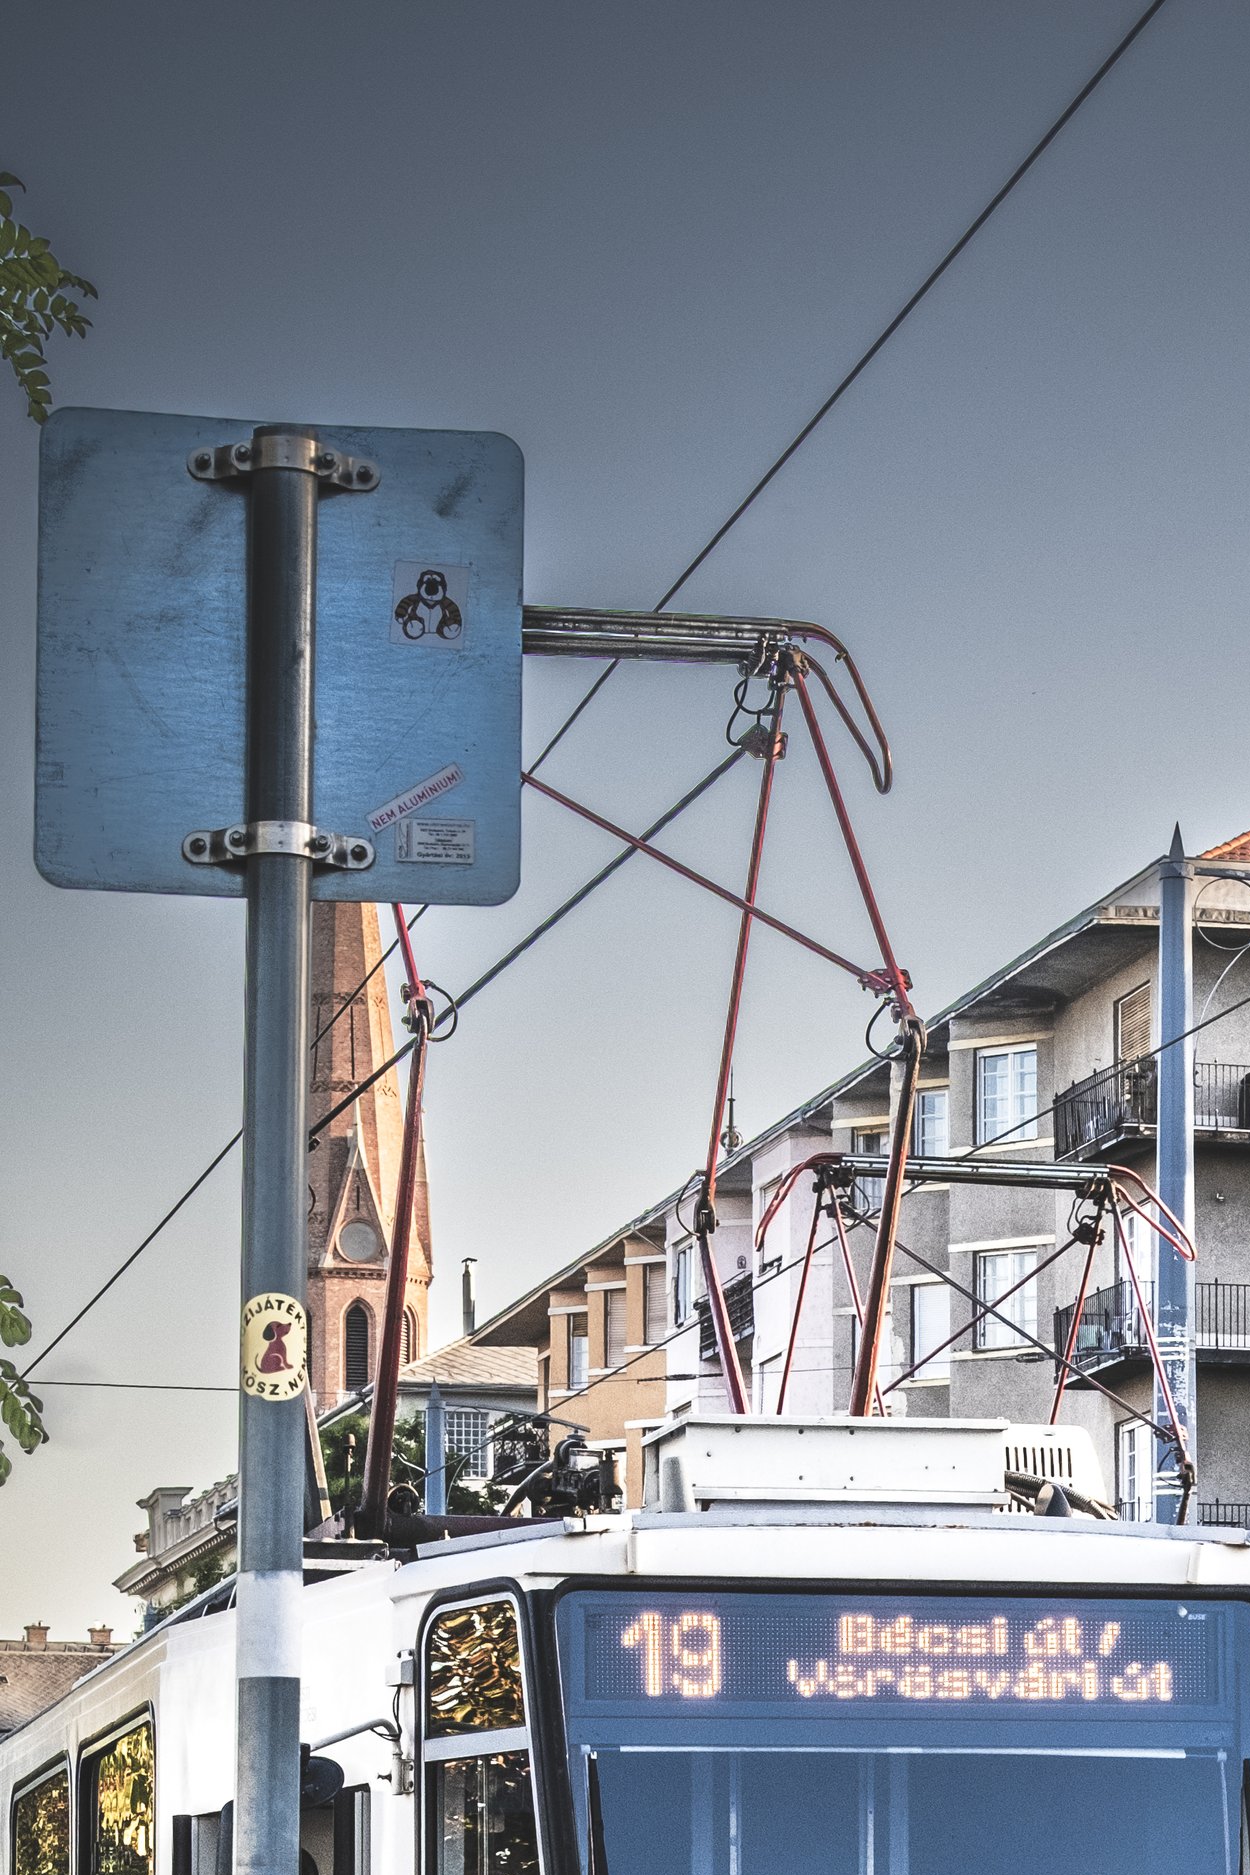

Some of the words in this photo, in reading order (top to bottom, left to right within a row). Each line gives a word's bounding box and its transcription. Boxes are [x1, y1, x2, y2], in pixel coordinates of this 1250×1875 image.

[371, 809, 397, 829] NEM
[398, 770, 460, 815] ALUMÍNIUM!
[242, 1296, 305, 1334] ZIJÁTÉK
[621, 1612, 721, 1697] 19
[838, 1614, 1007, 1656] Bécsi
[1023, 1616, 1083, 1656] út
[786, 1659, 1098, 1700] Vörösvári
[1110, 1660, 1173, 1701] út
